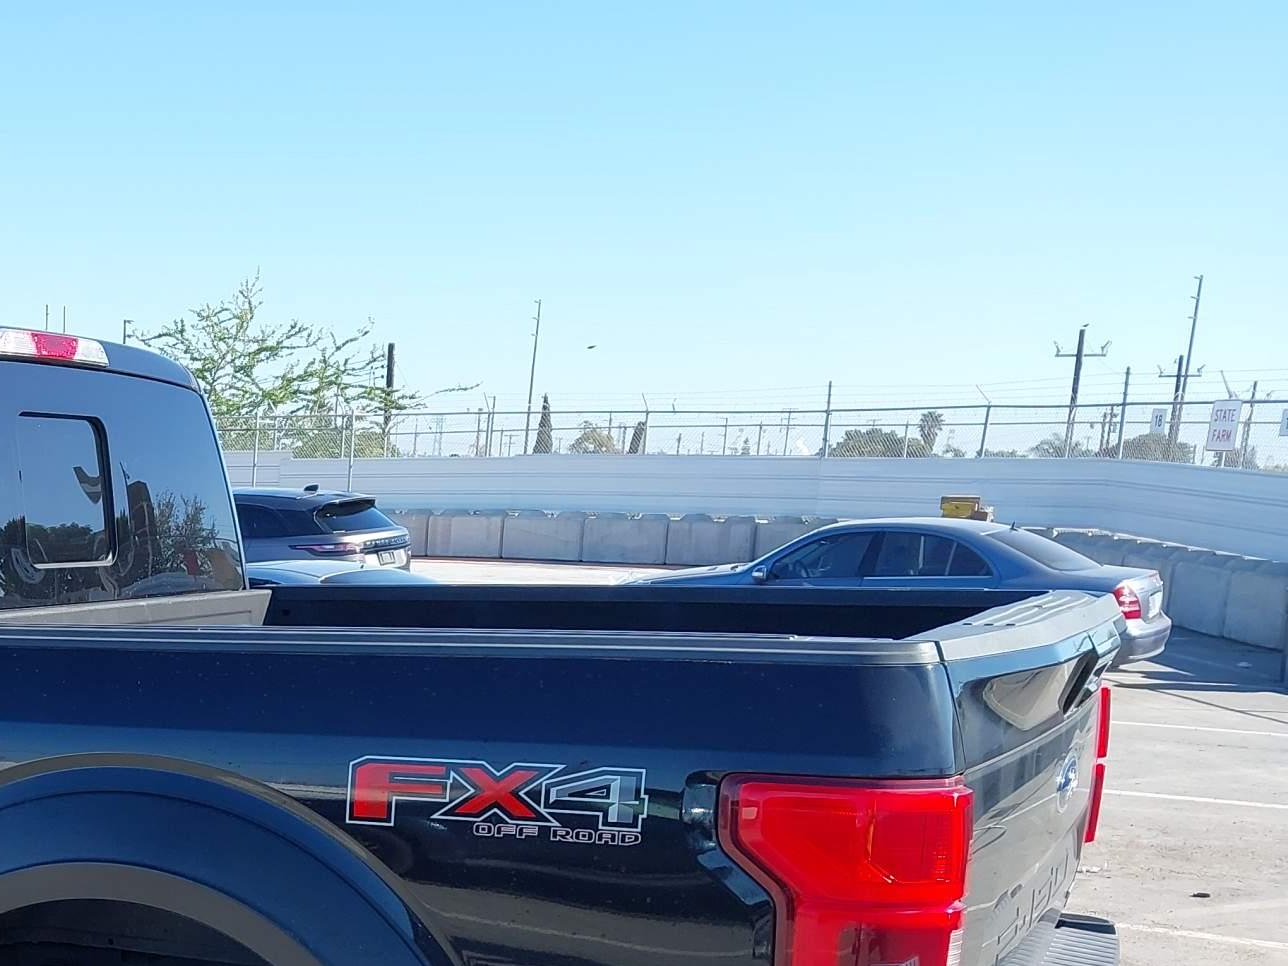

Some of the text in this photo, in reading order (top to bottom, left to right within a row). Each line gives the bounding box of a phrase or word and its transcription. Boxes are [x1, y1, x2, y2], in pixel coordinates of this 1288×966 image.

[1214, 408, 1236, 422] STATE
[346, 755, 649, 831] FX4
[472, 822, 642, 846] OFF ROAD
